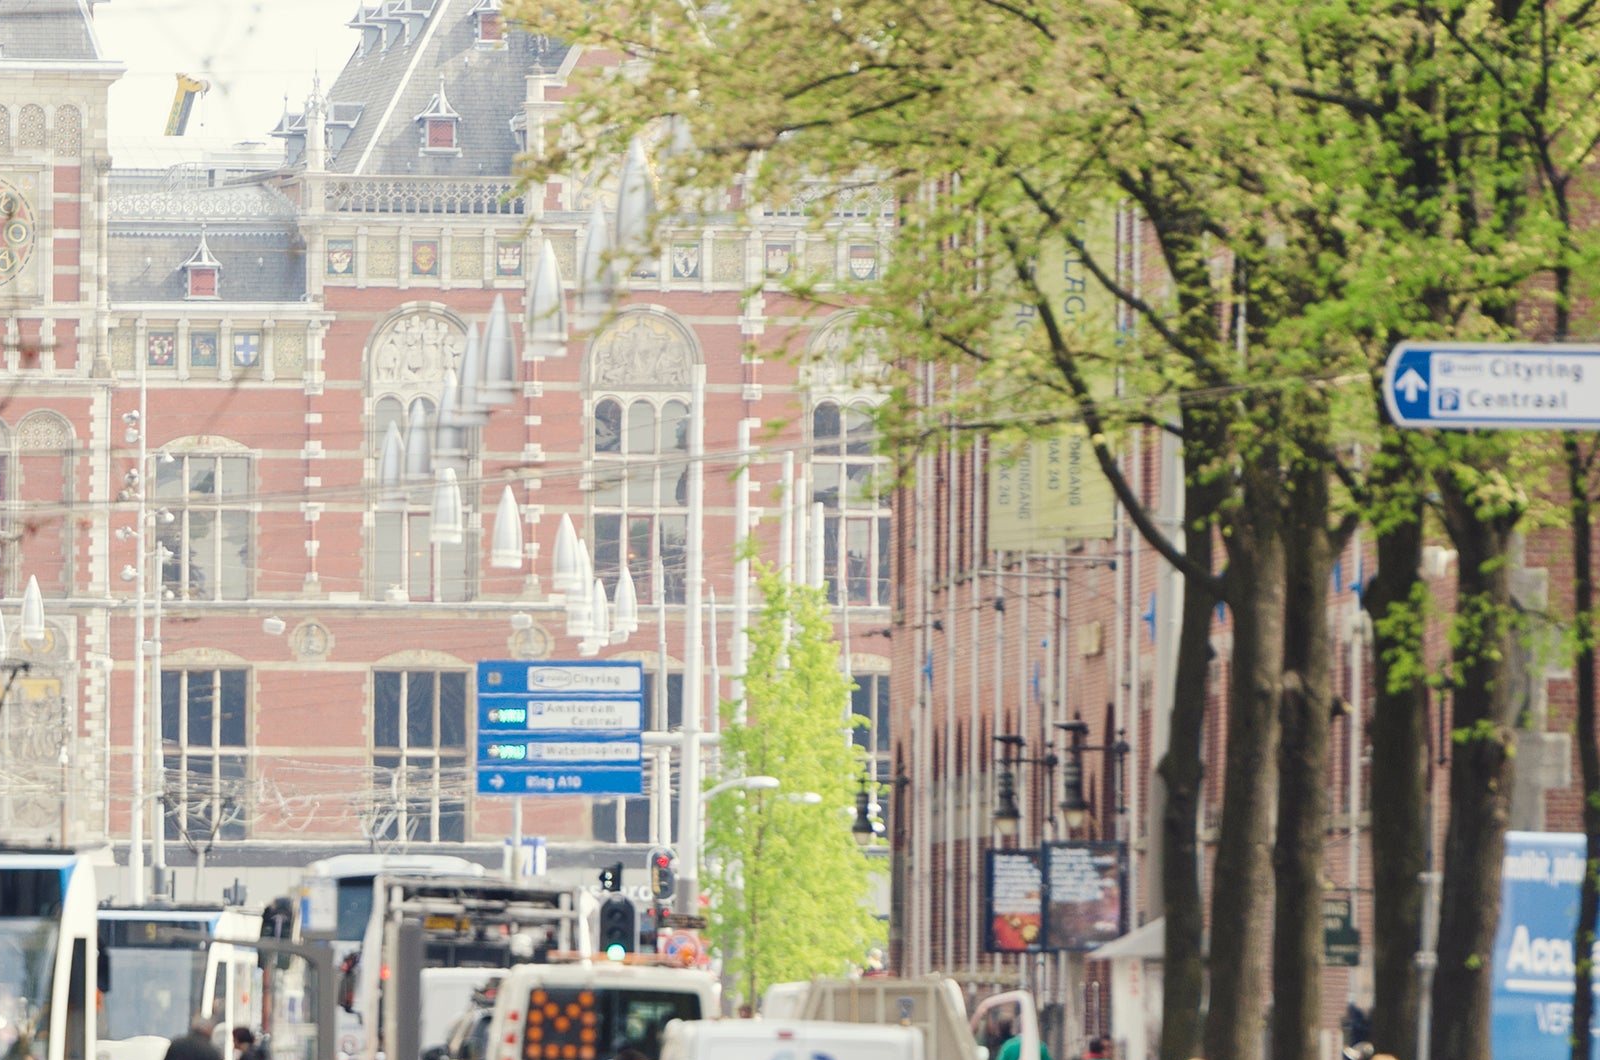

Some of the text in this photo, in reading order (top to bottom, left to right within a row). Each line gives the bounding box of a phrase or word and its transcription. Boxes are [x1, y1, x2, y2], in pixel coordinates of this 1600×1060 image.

[8, 223, 27, 243] O
[1489, 358, 1584, 382] Cityring
[1466, 389, 1568, 408] Centraal
[573, 673, 621, 686] Cityring
[571, 716, 623, 727] Centraal
[525, 775, 583, 791] Ring A10
